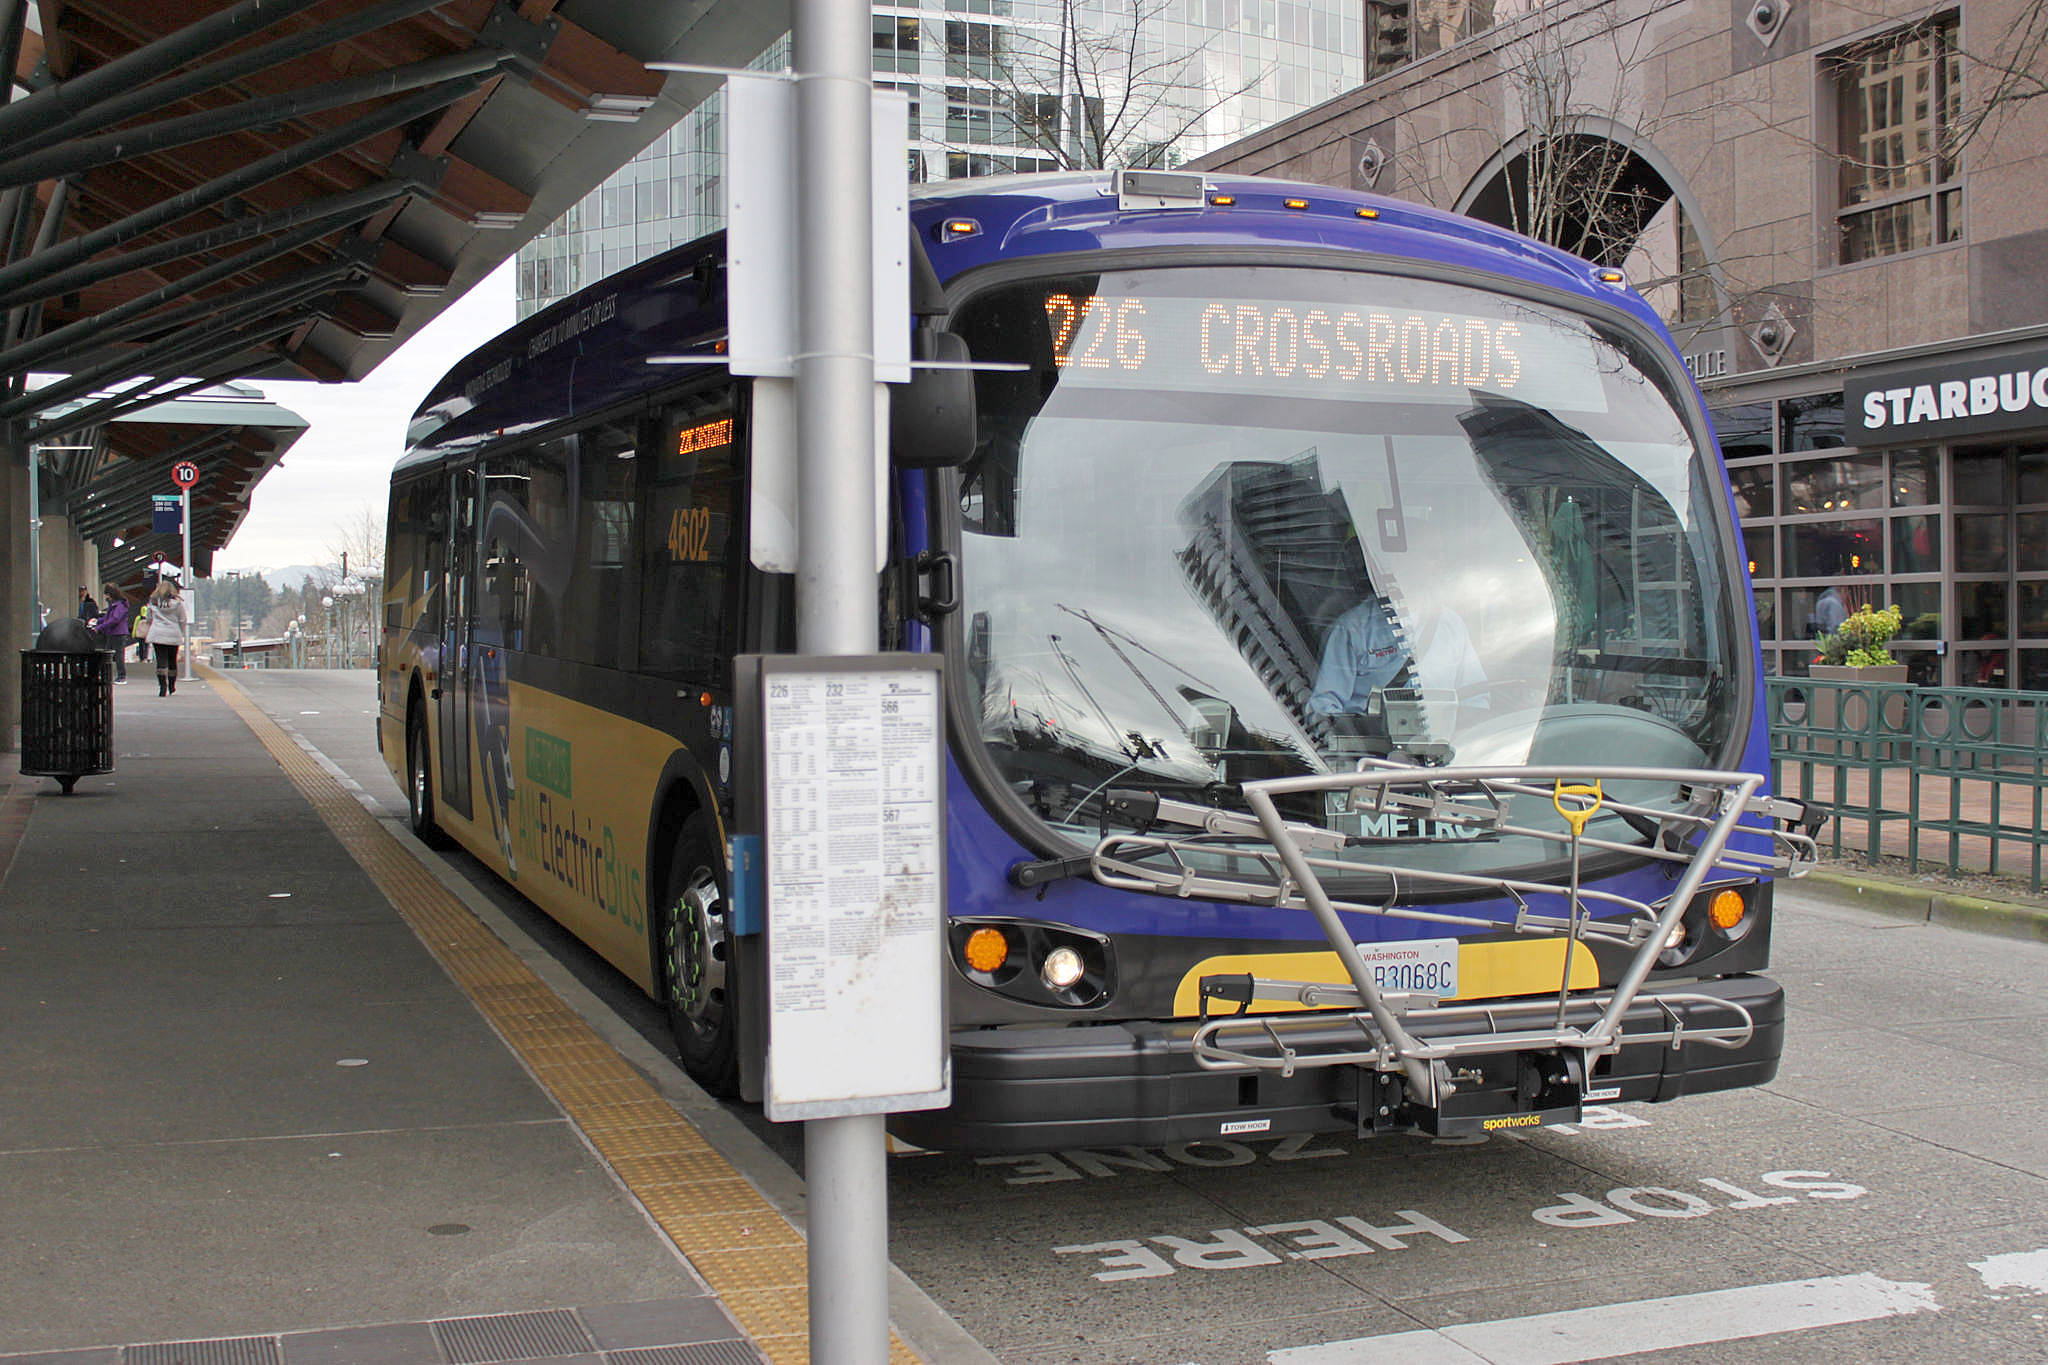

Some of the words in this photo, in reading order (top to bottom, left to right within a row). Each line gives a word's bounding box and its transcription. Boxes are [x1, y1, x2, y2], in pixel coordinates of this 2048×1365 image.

[1044, 294, 1147, 370] 226
[1200, 303, 1522, 388] CROSSROADS
[179, 468, 194, 481] 10
[668, 506, 710, 561] 4602
[826, 683, 844, 697] 232
[881, 700, 899, 714] 566
[883, 809, 900, 822] 567
[1360, 813, 1482, 838] METRO
[1363, 951, 1420, 961] WASHINGTON
[1230, 1124, 1246, 1132] TOW
[1248, 1122, 1267, 1130] HOOK
[1483, 1115, 1541, 1131] sportworks
[1531, 1170, 1868, 1229] STOP
[1053, 1210, 1472, 1282] HERE
